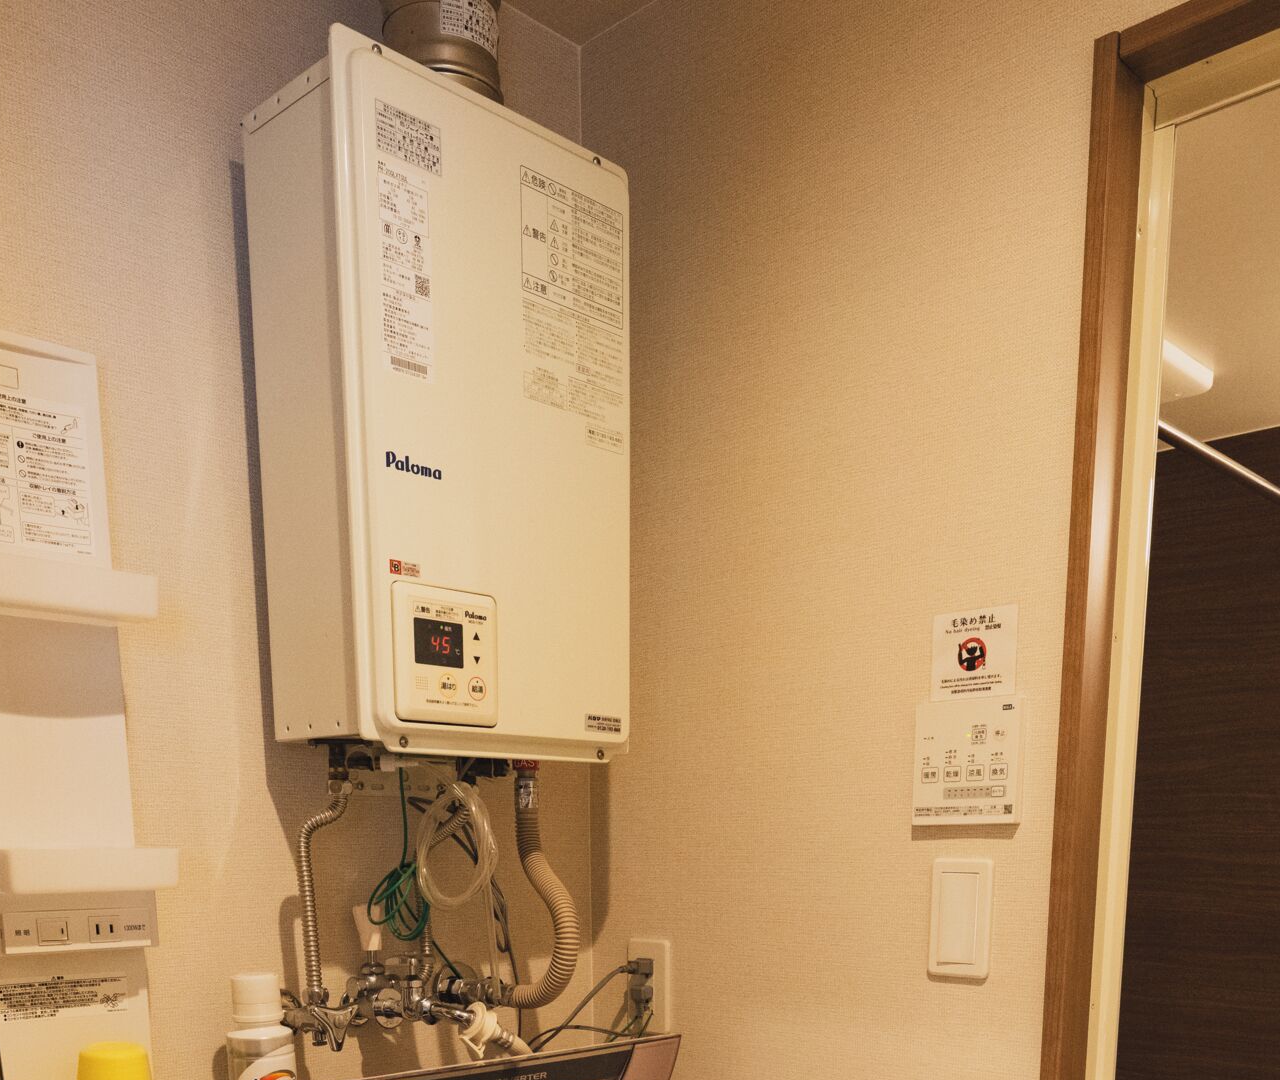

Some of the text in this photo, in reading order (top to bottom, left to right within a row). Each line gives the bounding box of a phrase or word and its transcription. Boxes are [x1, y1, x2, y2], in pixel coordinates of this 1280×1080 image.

[385, 451, 442, 480] Paloma
[464, 610, 487, 621] Paloma
[952, 613, 996, 628] 毛染め禁止
[431, 635, 450, 654] 45
[441, 681, 457, 691] 湯はり
